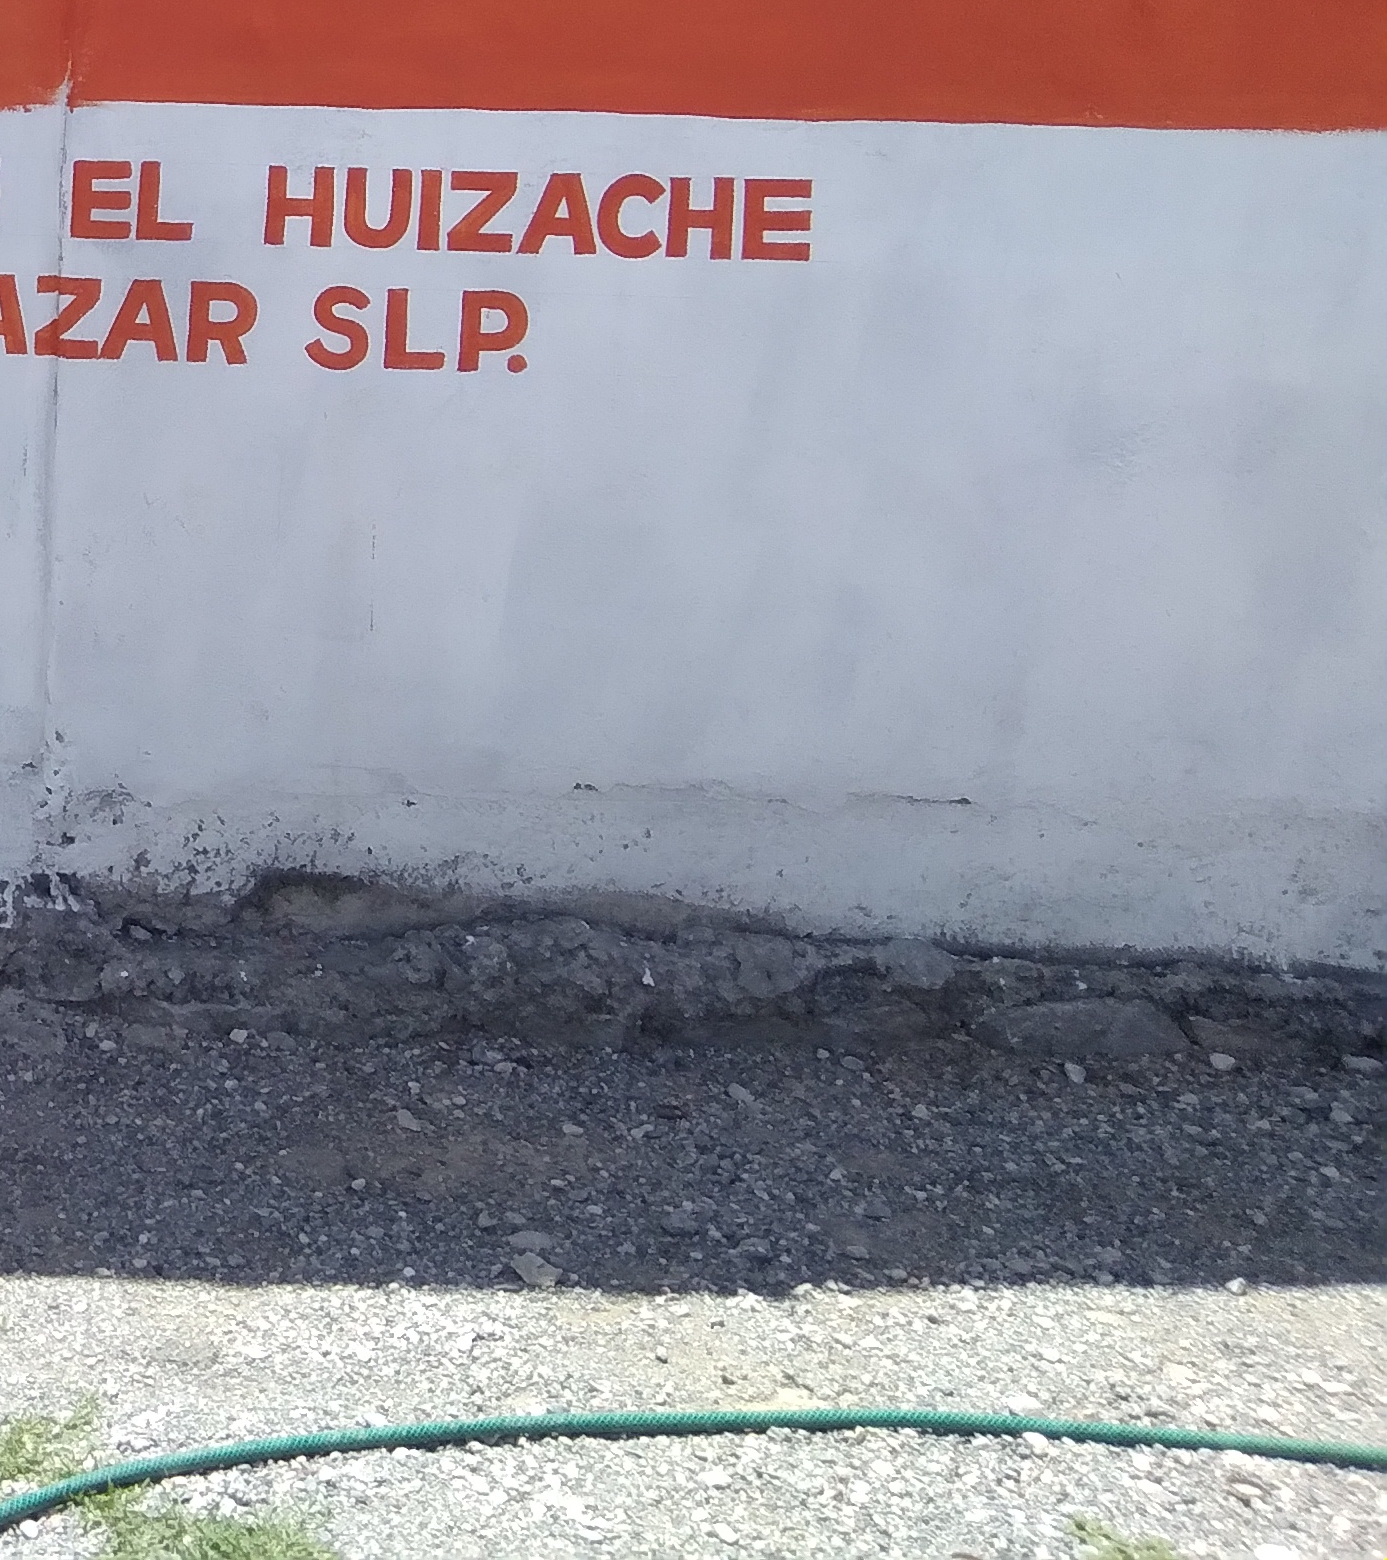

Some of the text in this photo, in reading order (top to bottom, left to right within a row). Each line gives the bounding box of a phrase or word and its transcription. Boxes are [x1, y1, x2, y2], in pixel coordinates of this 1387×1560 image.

[69, 159, 194, 242] EL
[263, 164, 813, 263] HUIZACHE
[304, 285, 529, 373] SLP.
